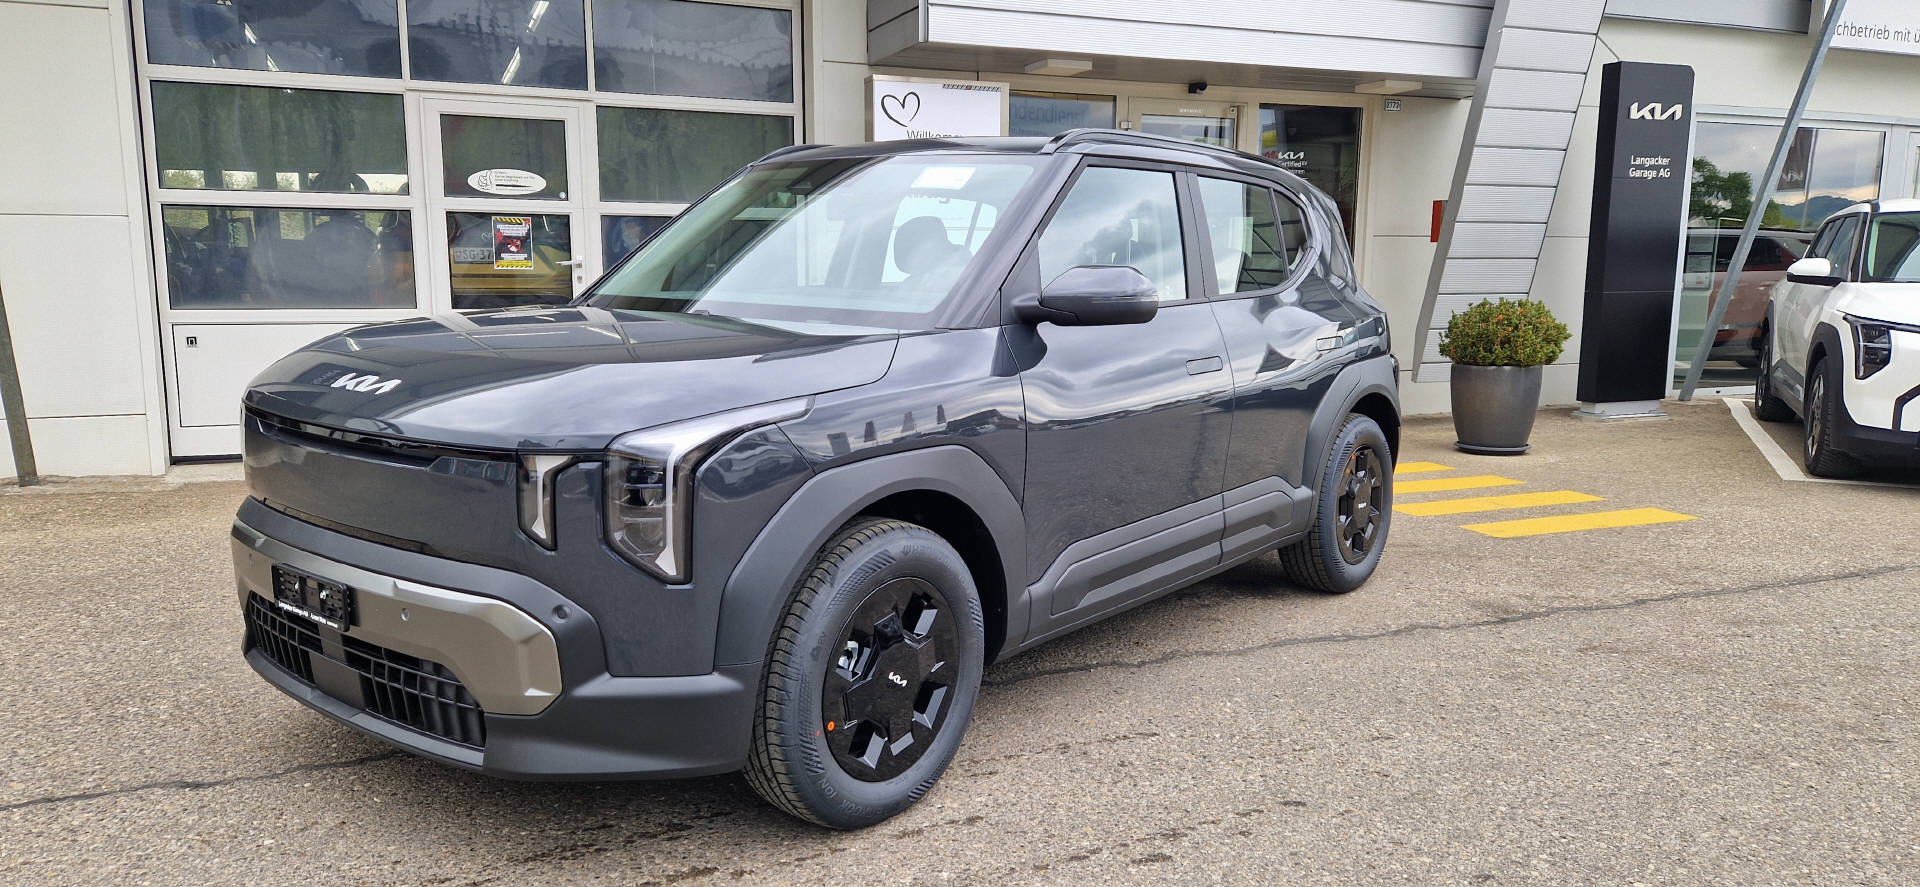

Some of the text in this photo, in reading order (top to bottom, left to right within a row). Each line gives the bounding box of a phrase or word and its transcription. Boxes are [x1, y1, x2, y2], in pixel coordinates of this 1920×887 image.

[1835, 21, 1890, 40] chbetrieb
[1893, 28, 1911, 42] mit
[1629, 102, 1683, 120] KIA
[1630, 155, 1671, 168] Langacker
[1629, 167, 1671, 179] Garage AG
[330, 372, 402, 395] KIA
[888, 671, 907, 687] KIA
